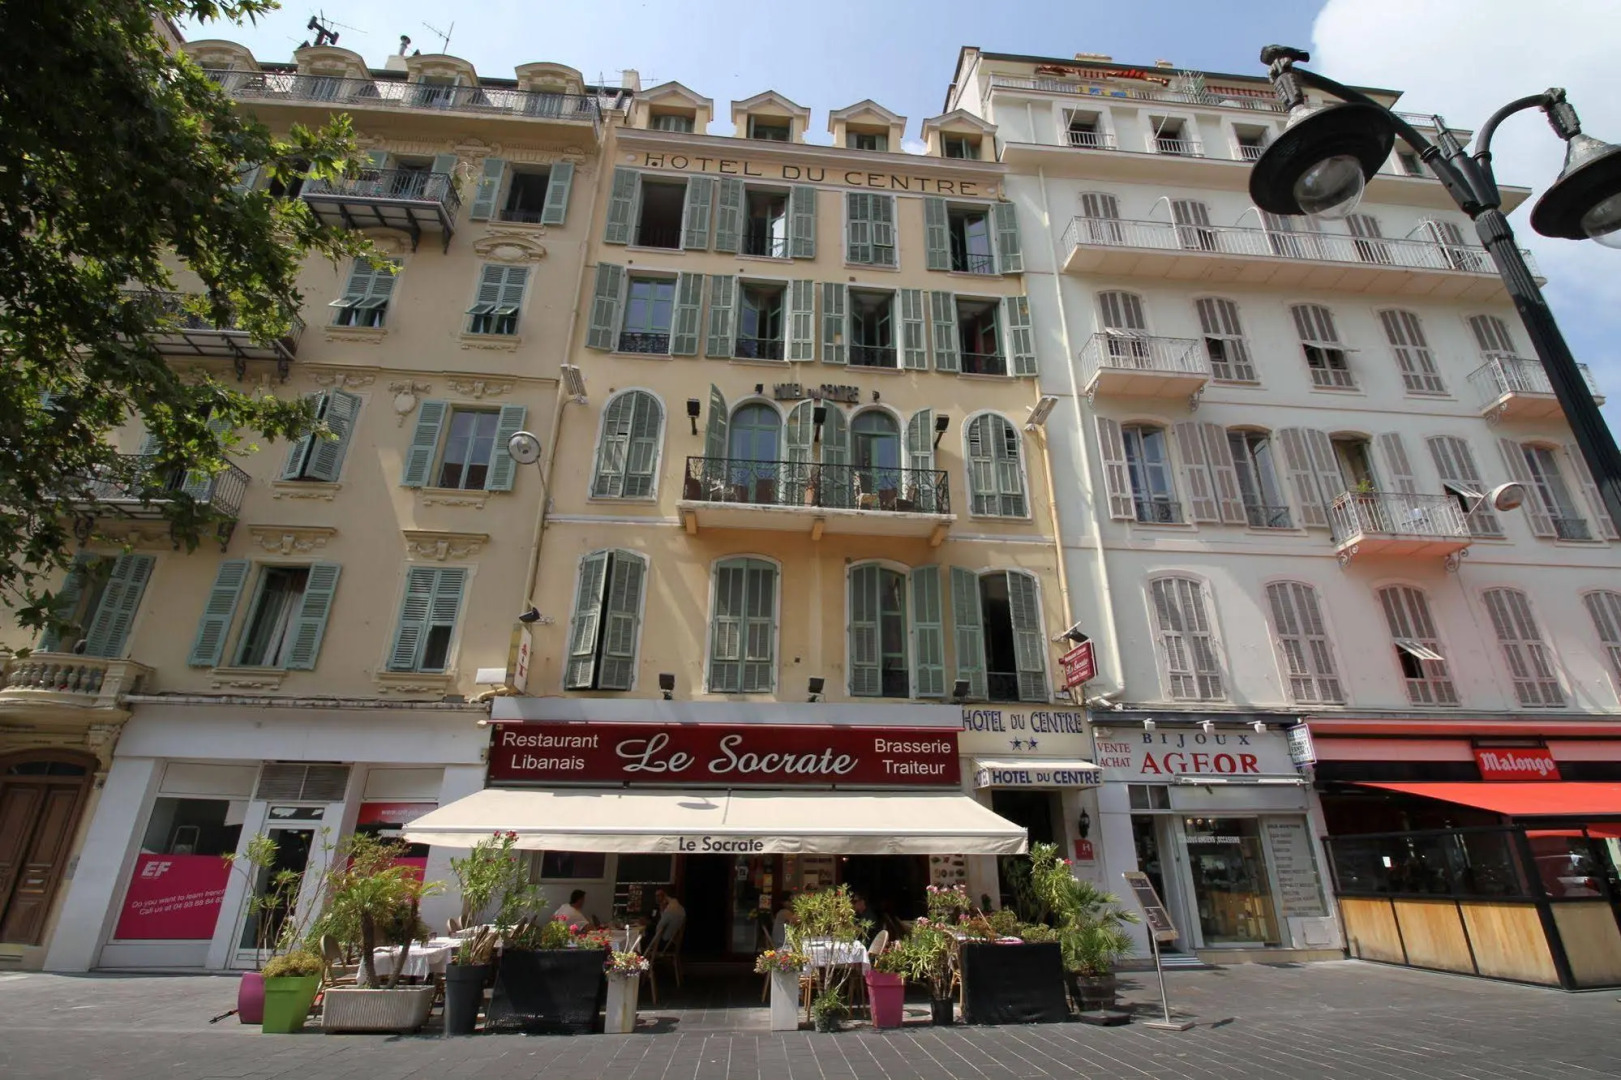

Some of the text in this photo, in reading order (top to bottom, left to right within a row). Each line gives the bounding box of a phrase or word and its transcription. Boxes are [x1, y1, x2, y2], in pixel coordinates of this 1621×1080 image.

[645, 152, 978, 196] HOTEL DU CENTRE
[962, 709, 1083, 734] HOTEL DU CENTRE
[502, 731, 599, 748] Restaurant
[874, 738, 951, 754] Brasserie
[1097, 742, 1131, 753] VENTE
[1142, 733, 1250, 748] BIJOUX
[615, 732, 859, 774] Le Socrate
[511, 754, 585, 770] Libanais
[882, 759, 946, 775] Traiteur
[1100, 757, 1131, 768] ACHAT
[1480, 752, 1555, 776] Malongo
[992, 770, 1100, 784] HOTEL DU CENTRE
[679, 836, 764, 852] Le Socrate
[141, 861, 172, 876] EF
[140, 907, 153, 915] Call
[144, 899, 157, 908] you
